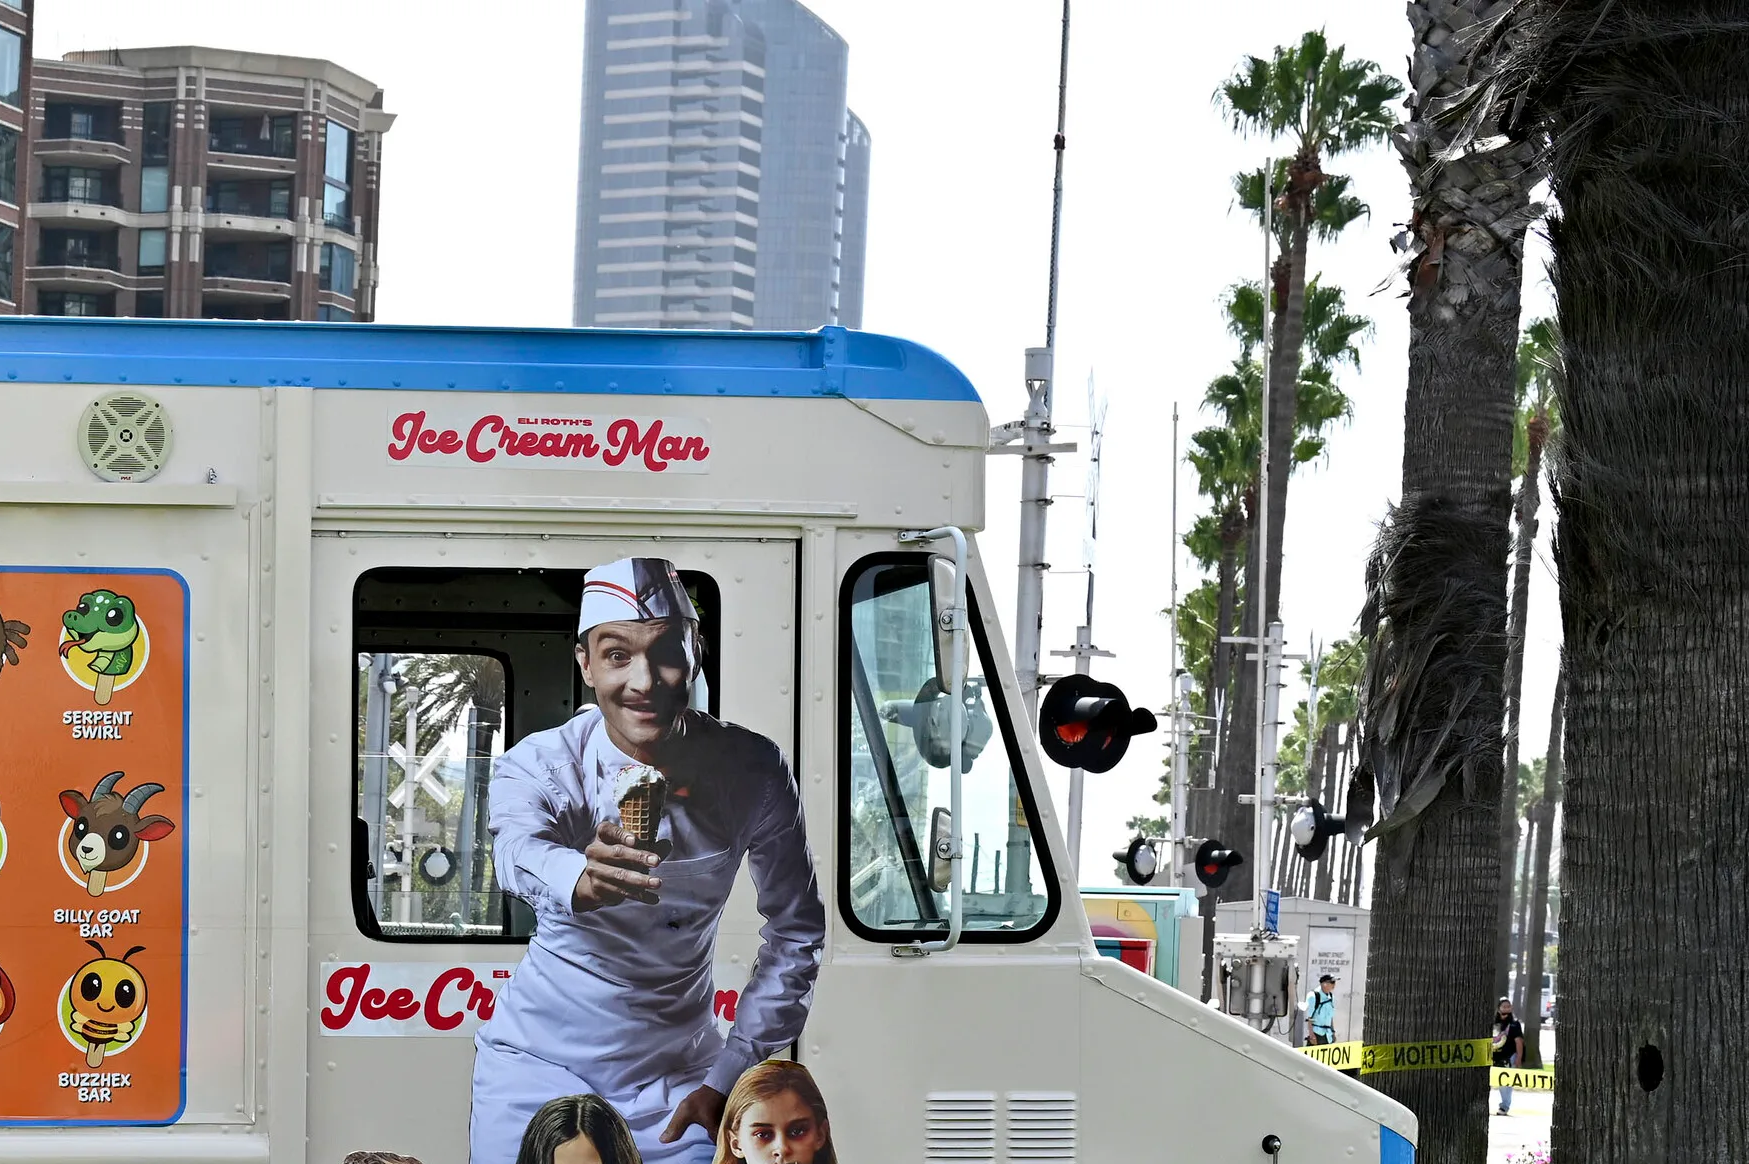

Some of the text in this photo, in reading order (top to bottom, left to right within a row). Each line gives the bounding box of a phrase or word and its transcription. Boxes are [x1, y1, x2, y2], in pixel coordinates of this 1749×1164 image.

[517, 417, 593, 426] ELI ROTH'S
[388, 410, 710, 472] Ice Cream Man
[62, 710, 133, 726] SERPENT
[72, 725, 123, 740] SWIRL
[53, 909, 141, 924] BILLY GOAT
[79, 923, 114, 938] BAR
[321, 963, 421, 1030] Ice
[1304, 1045, 1351, 1067] UTION
[58, 1072, 131, 1088] BUZZHEX
[78, 1087, 112, 1102] BAR
